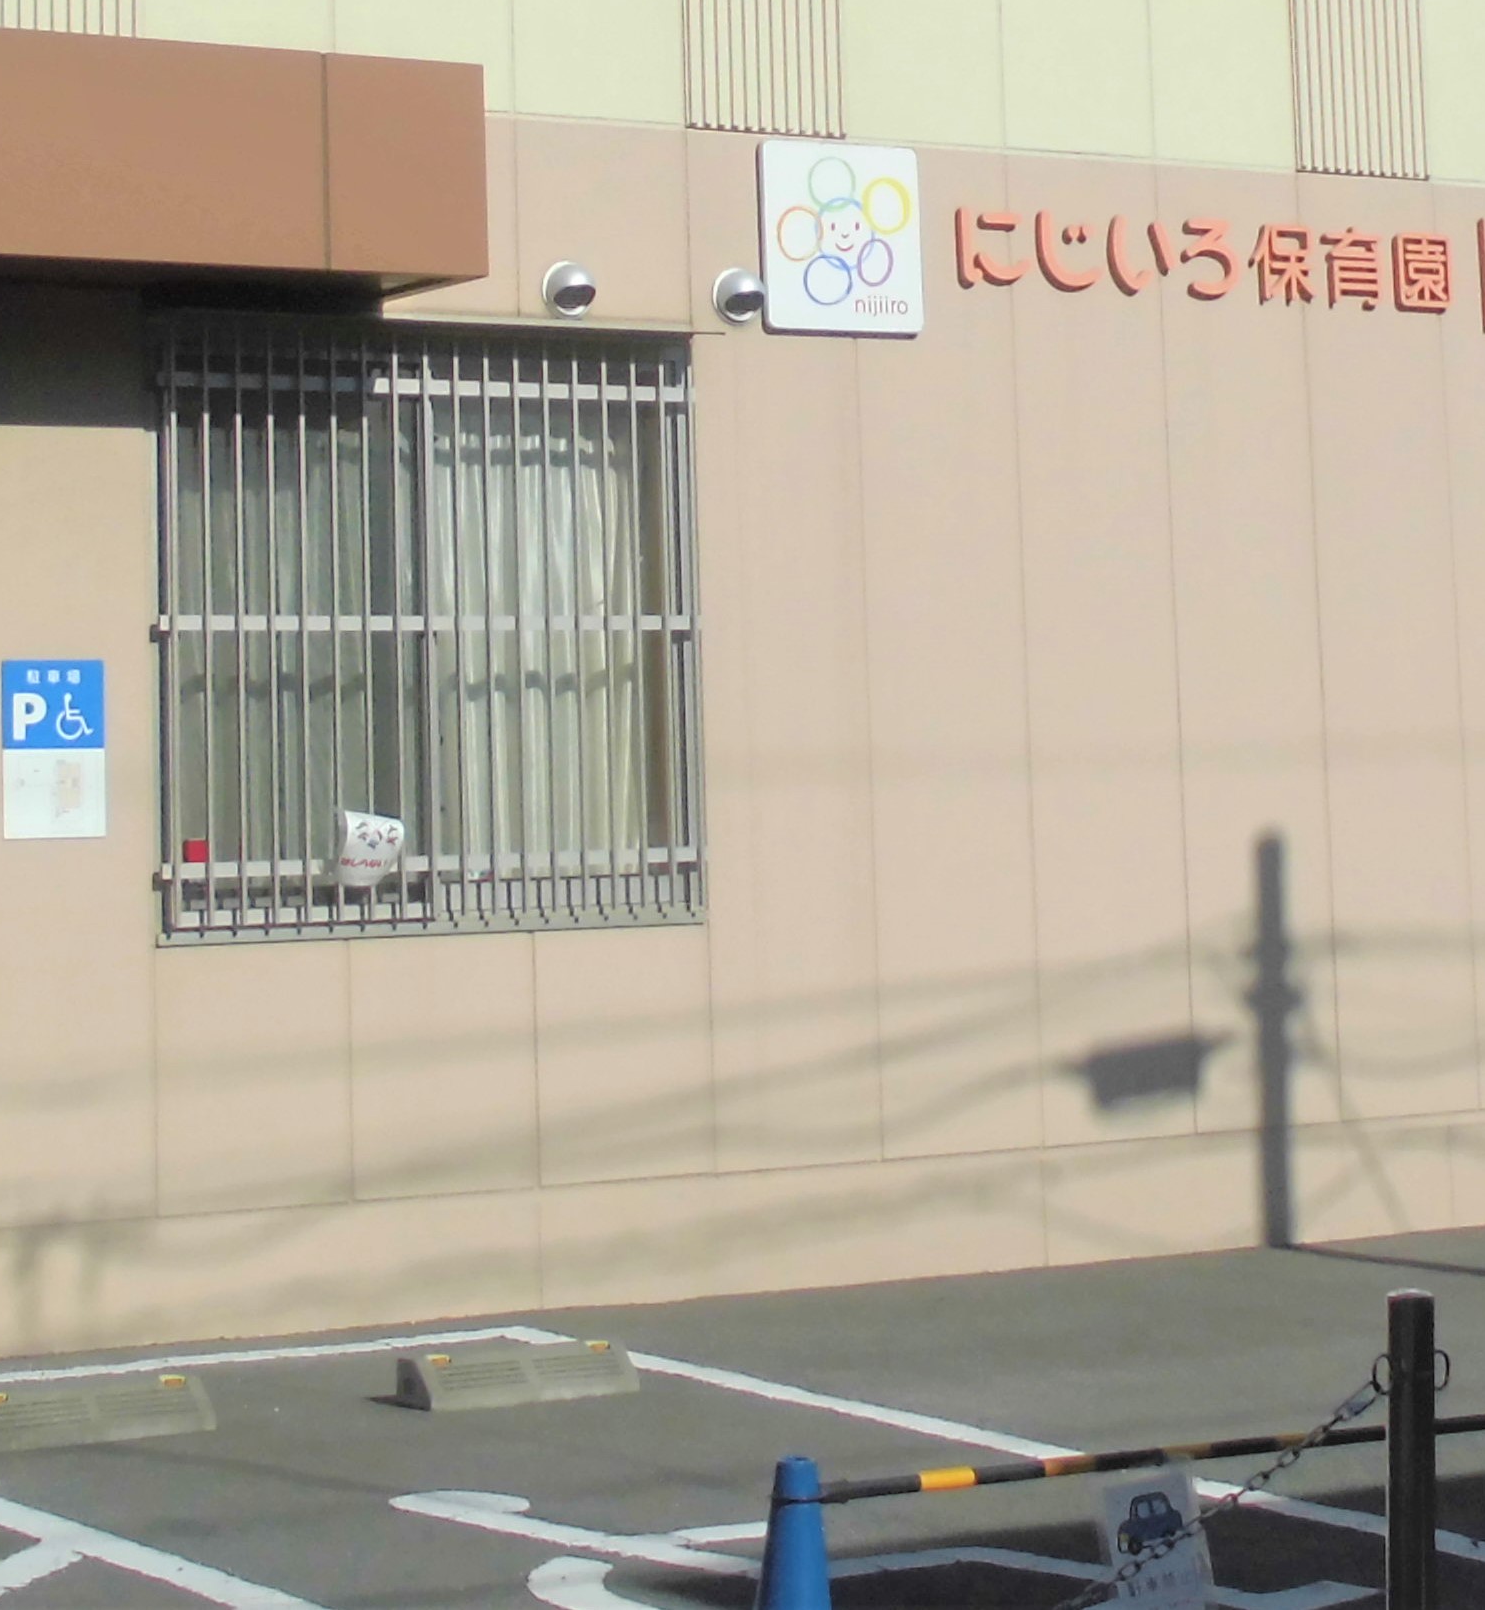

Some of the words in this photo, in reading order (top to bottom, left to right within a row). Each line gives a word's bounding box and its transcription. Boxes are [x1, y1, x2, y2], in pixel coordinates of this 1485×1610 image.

[954, 206, 1453, 314] にじいろ保育園
[854, 296, 909, 317] nijiiro
[12, 692, 48, 741] P
